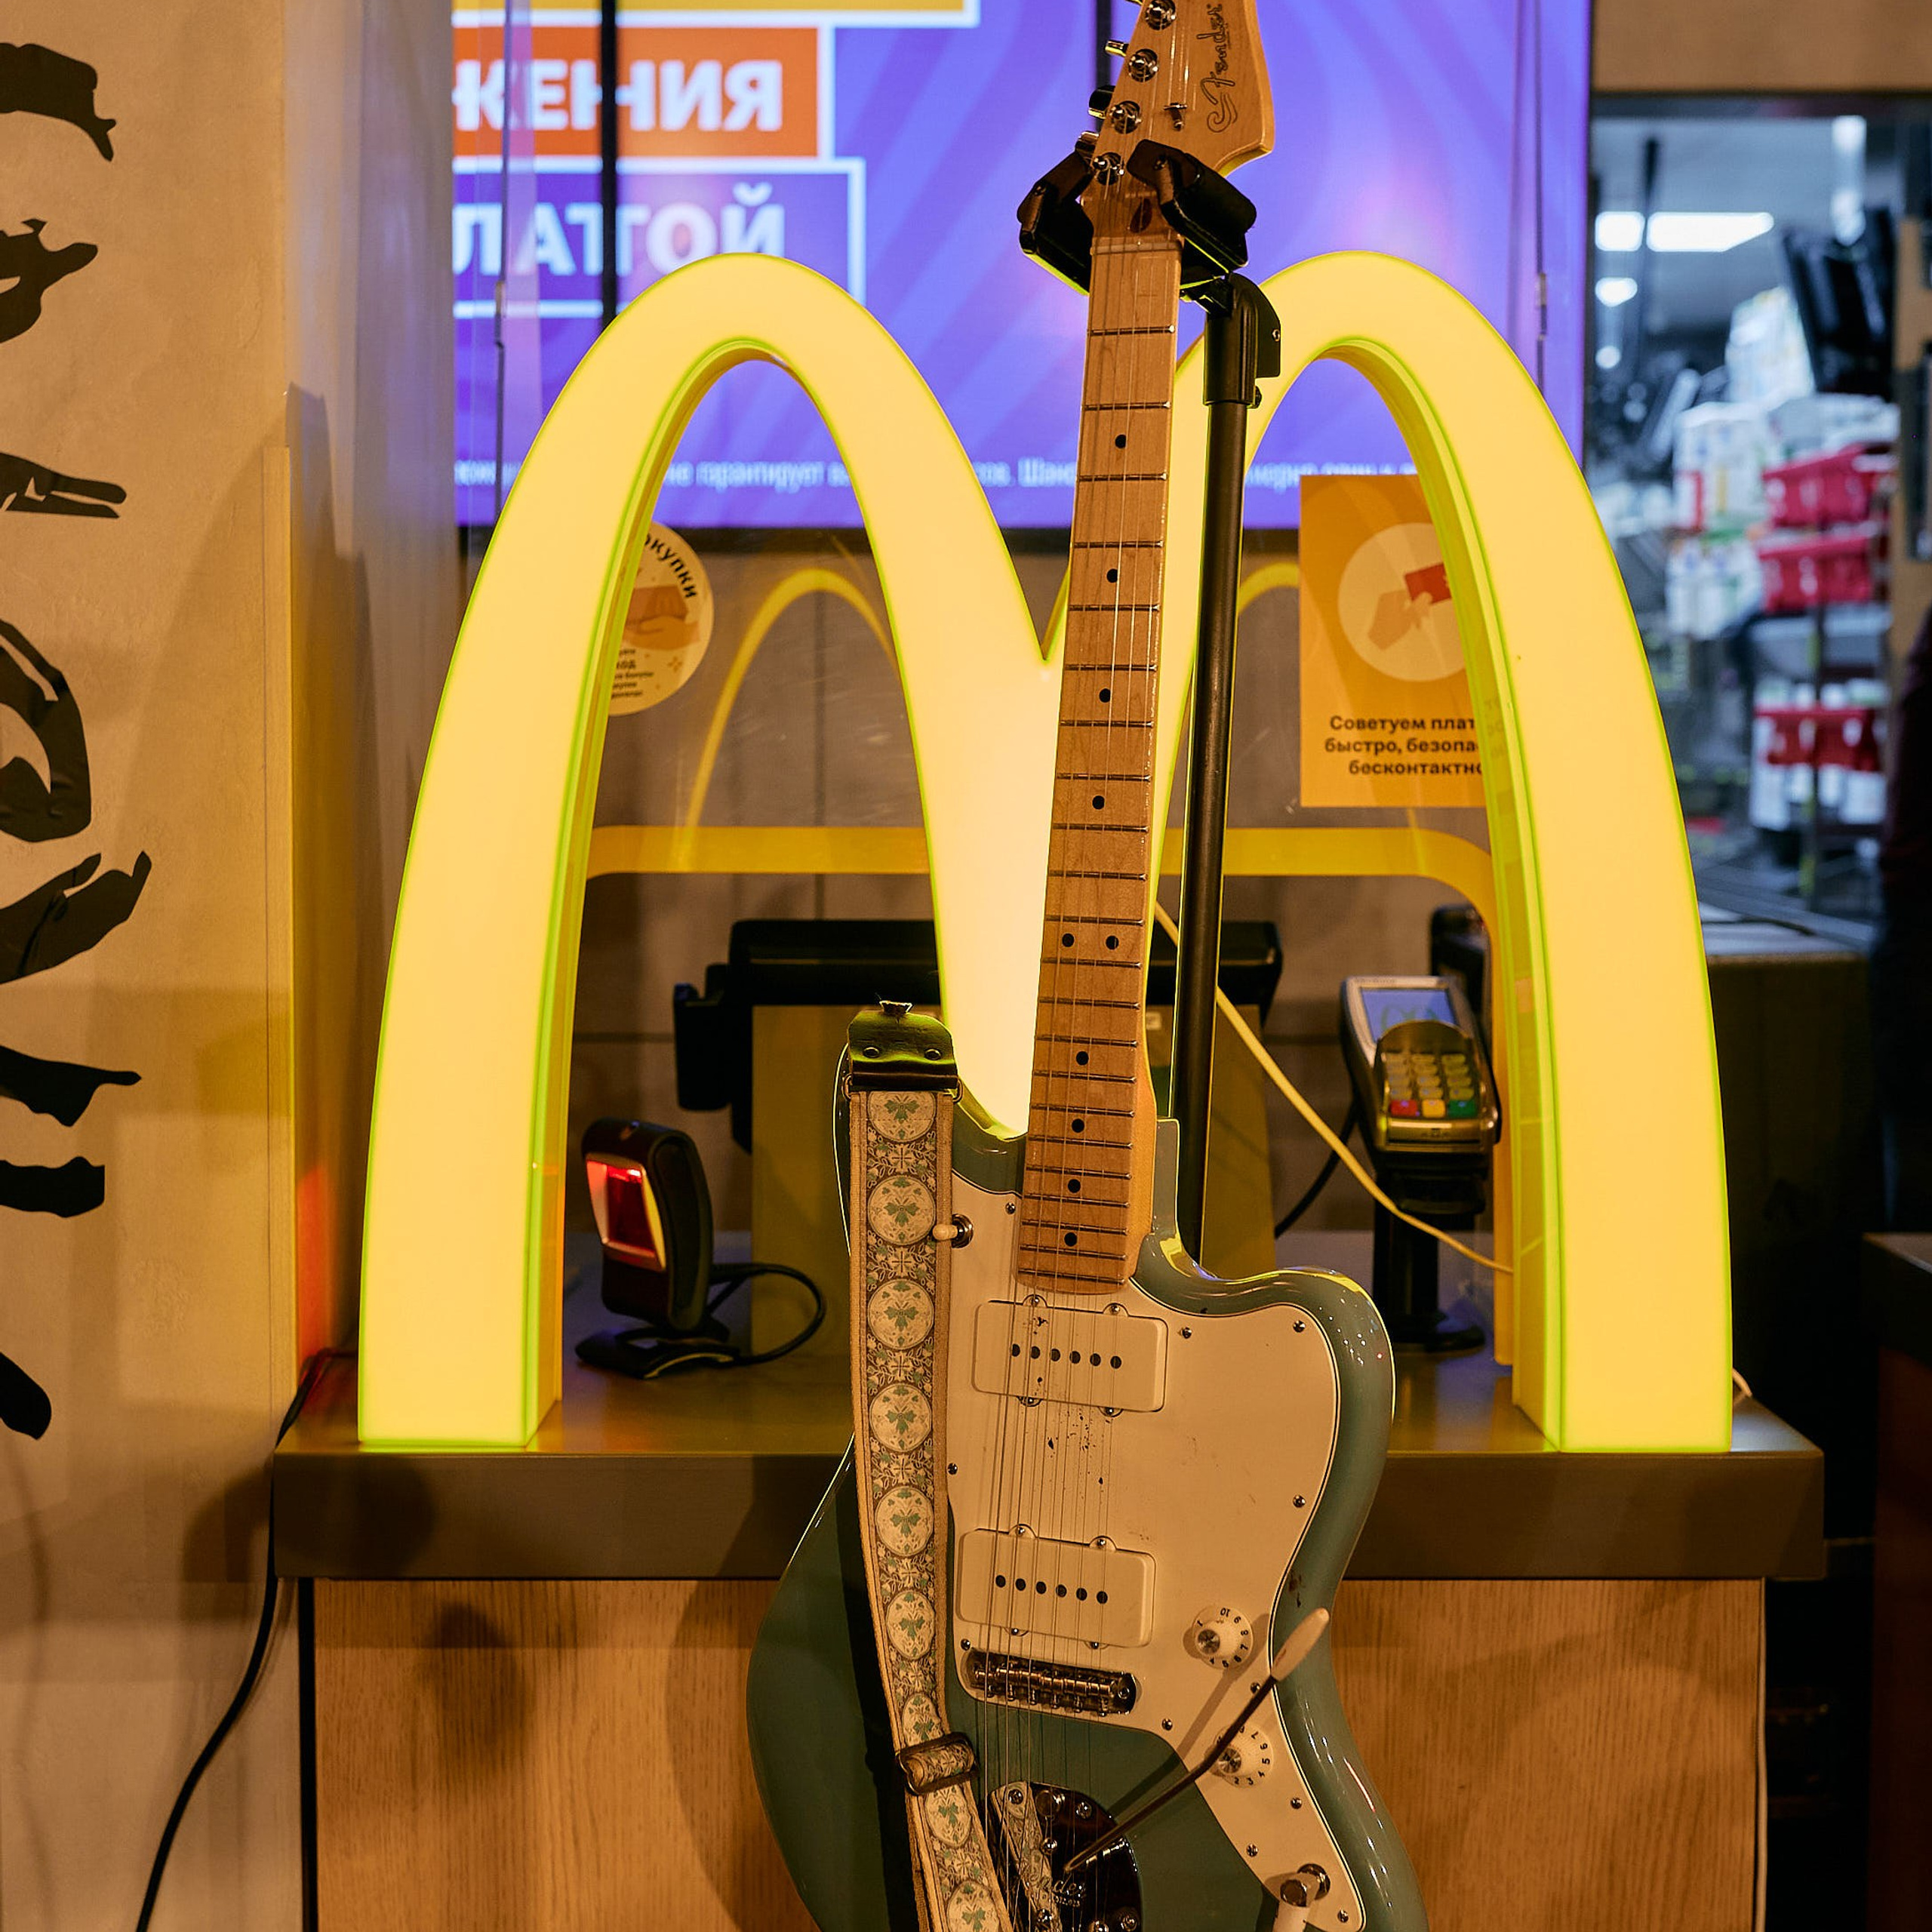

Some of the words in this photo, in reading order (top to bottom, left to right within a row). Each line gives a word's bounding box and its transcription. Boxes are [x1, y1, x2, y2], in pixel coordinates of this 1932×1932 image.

[1196, 3, 1238, 133] Fender
[1330, 715, 1426, 734] Советуем
[1324, 737, 1402, 756] быстро,
[1407, 737, 1478, 752] безопа
